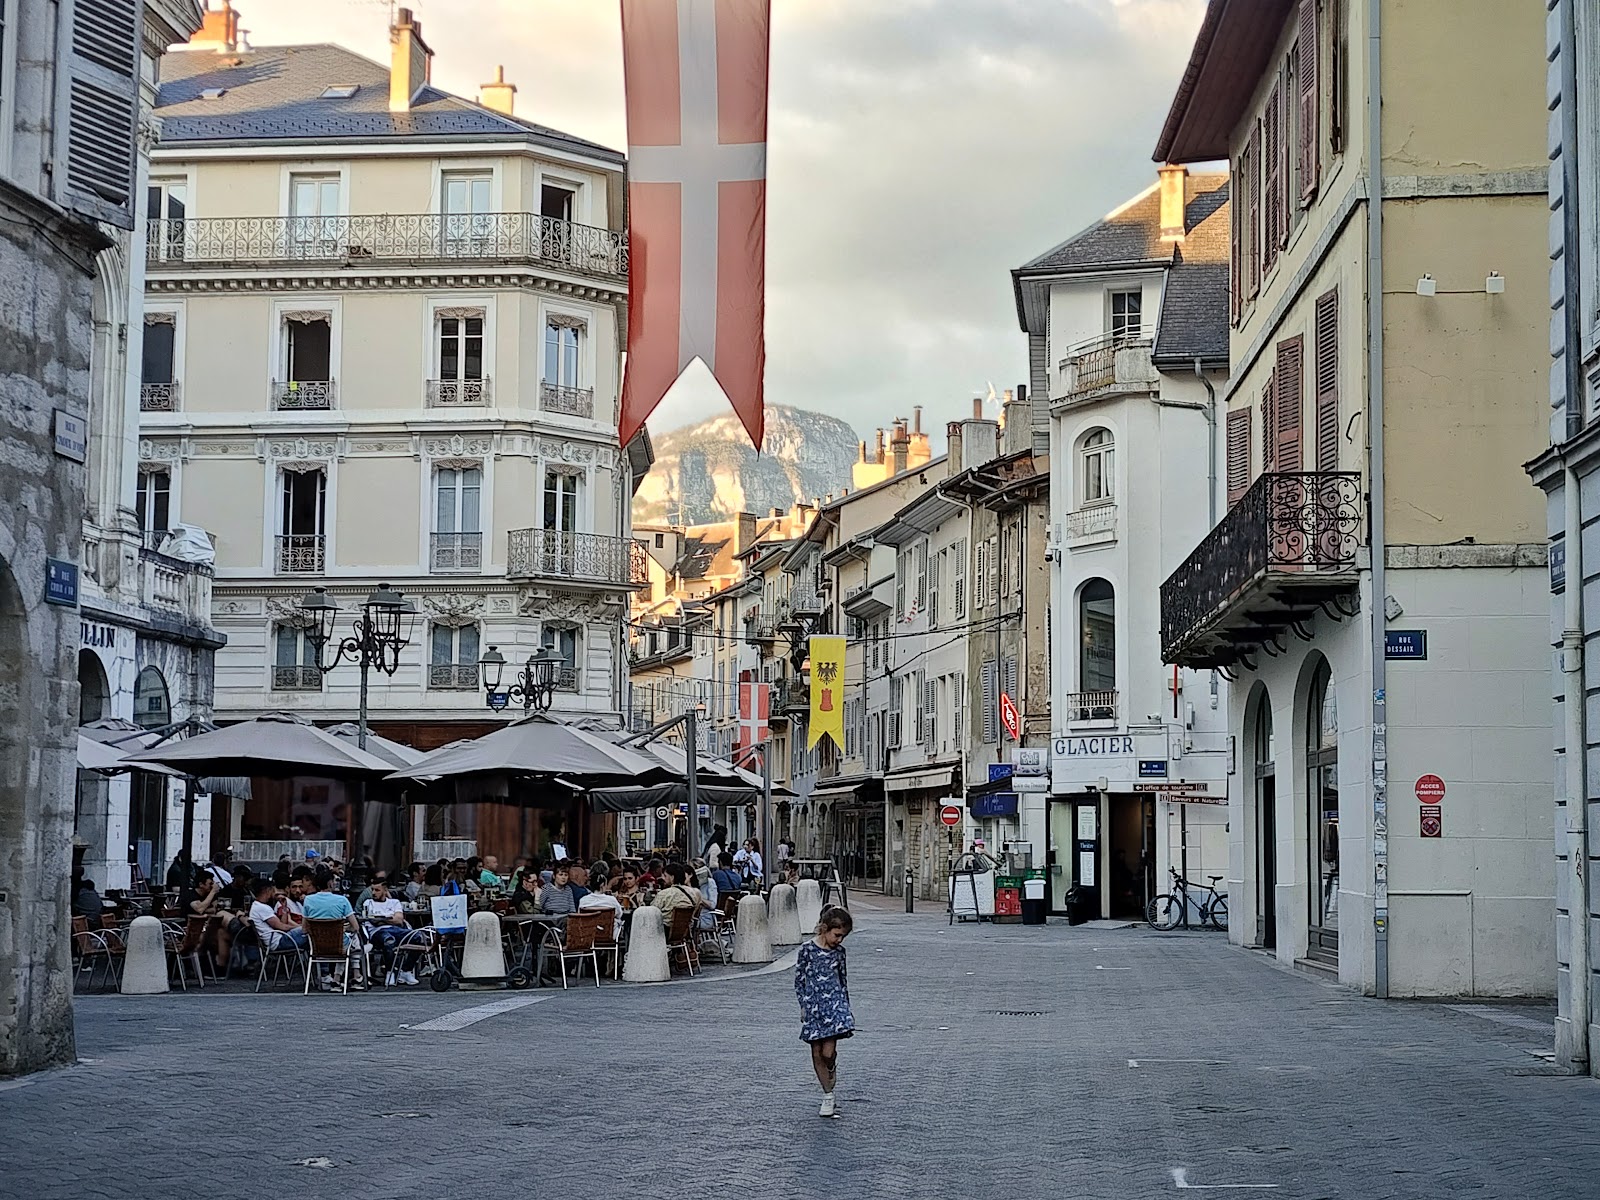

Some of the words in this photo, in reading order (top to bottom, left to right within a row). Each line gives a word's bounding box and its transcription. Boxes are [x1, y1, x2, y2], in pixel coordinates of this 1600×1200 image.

[1398, 636, 1411, 644] RUE
[1387, 645, 1414, 653] DESSAIX
[1004, 703, 1016, 730] TABAC
[1055, 737, 1134, 755] GLACIER
[1145, 783, 1160, 791] office
[1161, 783, 1169, 791] de
[1171, 783, 1194, 791] tourisme
